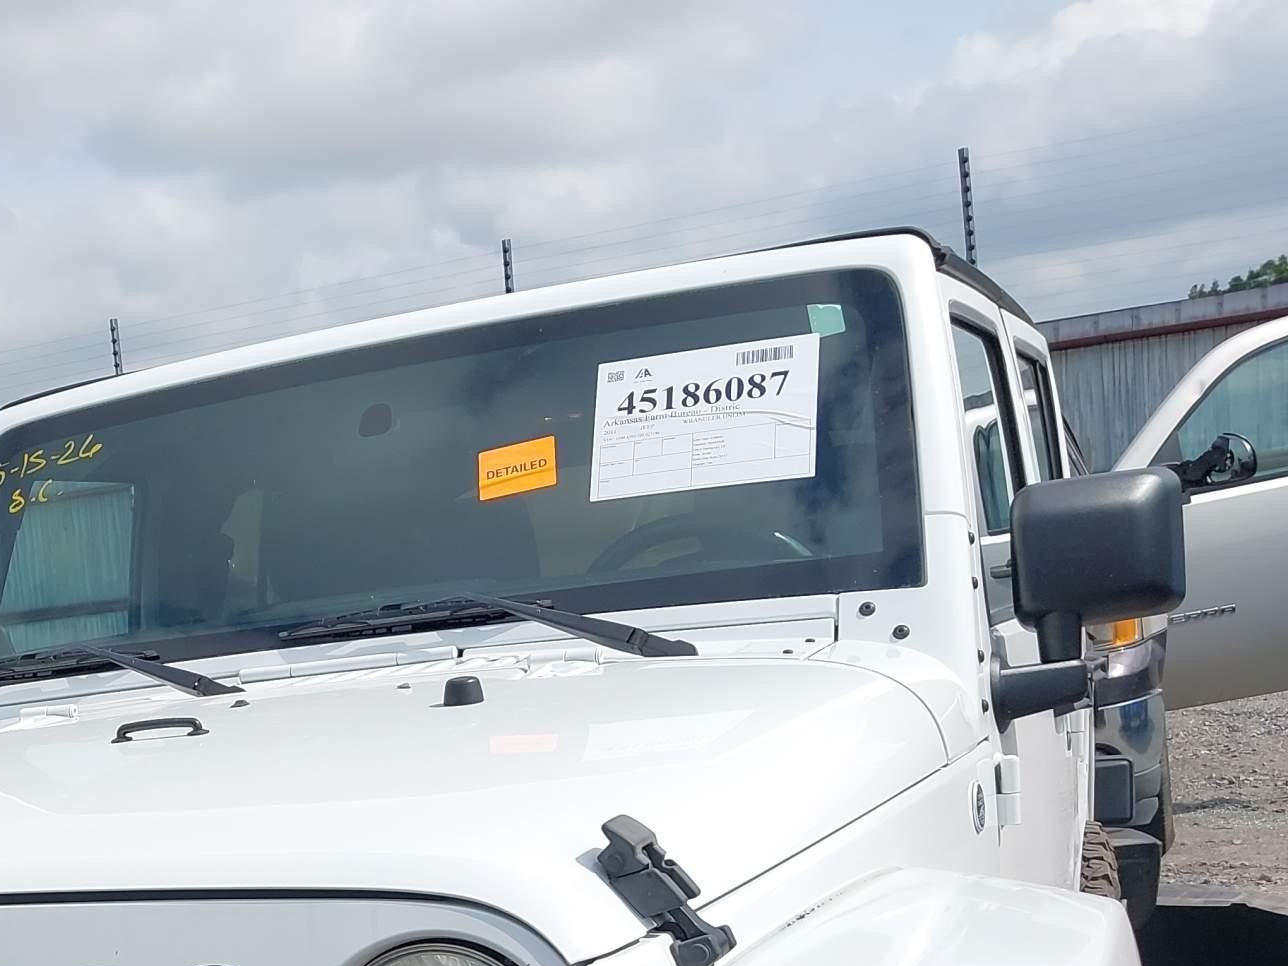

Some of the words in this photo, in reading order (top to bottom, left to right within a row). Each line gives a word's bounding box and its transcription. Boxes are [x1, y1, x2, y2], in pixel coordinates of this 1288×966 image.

[617, 370, 790, 415] 45186087
[603, 415, 643, 428] Arkansas
[486, 458, 548, 480] DETAILED
